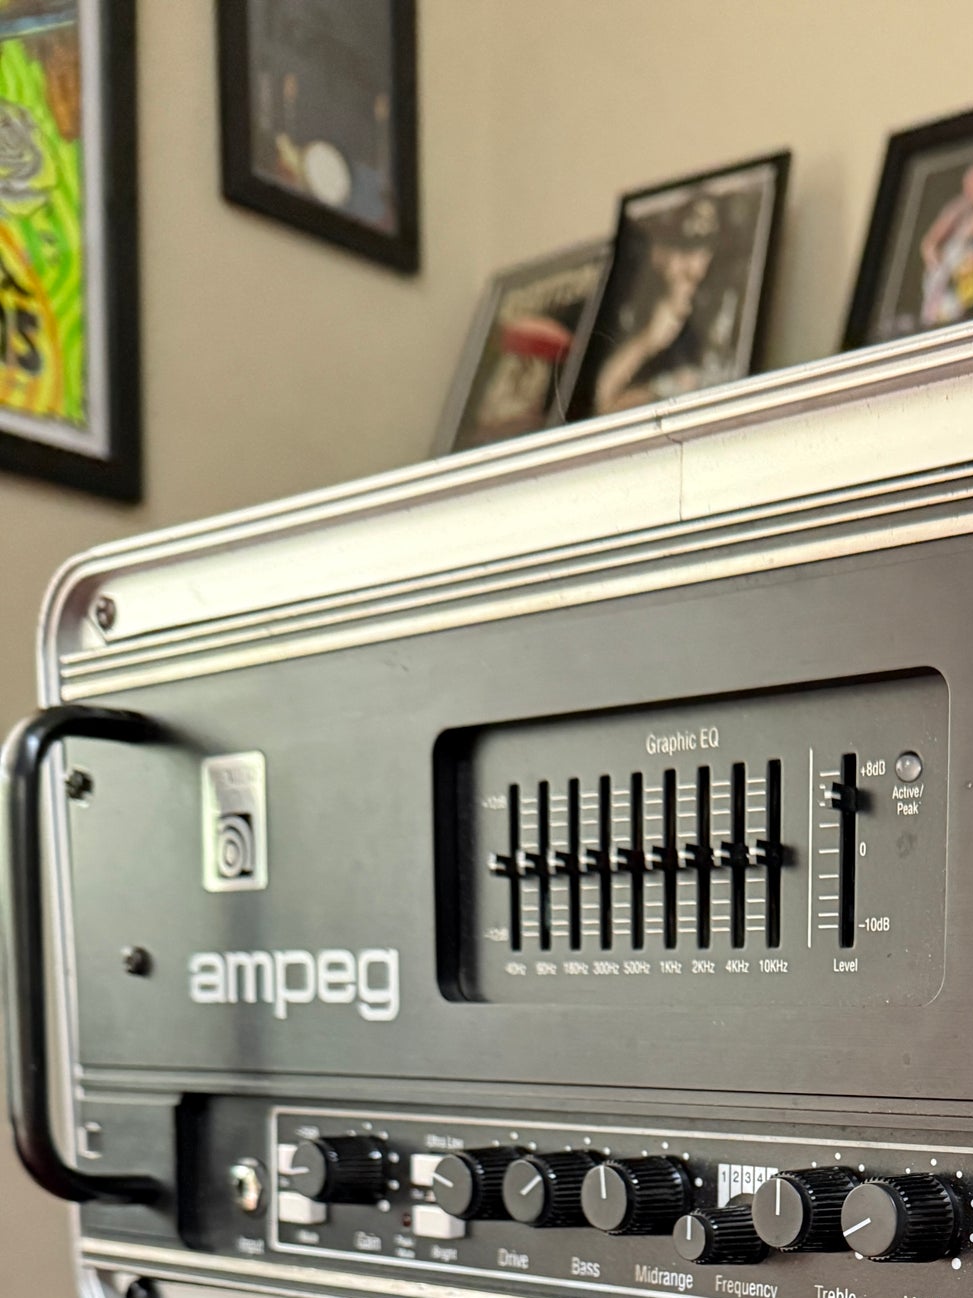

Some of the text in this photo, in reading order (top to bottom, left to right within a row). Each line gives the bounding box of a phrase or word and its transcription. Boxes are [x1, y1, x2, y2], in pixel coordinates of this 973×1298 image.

[646, 726, 719, 756] Graphic EQ
[860, 760, 886, 776] +8dB
[897, 802, 919, 816] Peak
[859, 842, 867, 857] 0
[592, 960, 620, 975] 300Hz
[623, 960, 651, 975] 500Hz
[659, 960, 682, 974] 1KHz
[691, 959, 715, 974] 2KHz
[725, 959, 750, 973] 4KHz
[759, 959, 788, 973] 10KHz
[833, 958, 858, 973] Level
[188, 948, 400, 1022] ampeg
[733, 1171, 739, 1183] 2
[744, 1171, 751, 1184] 3
[498, 1247, 529, 1270] Drive
[571, 1256, 600, 1279] Bass
[635, 1264, 694, 1291] Midrange
